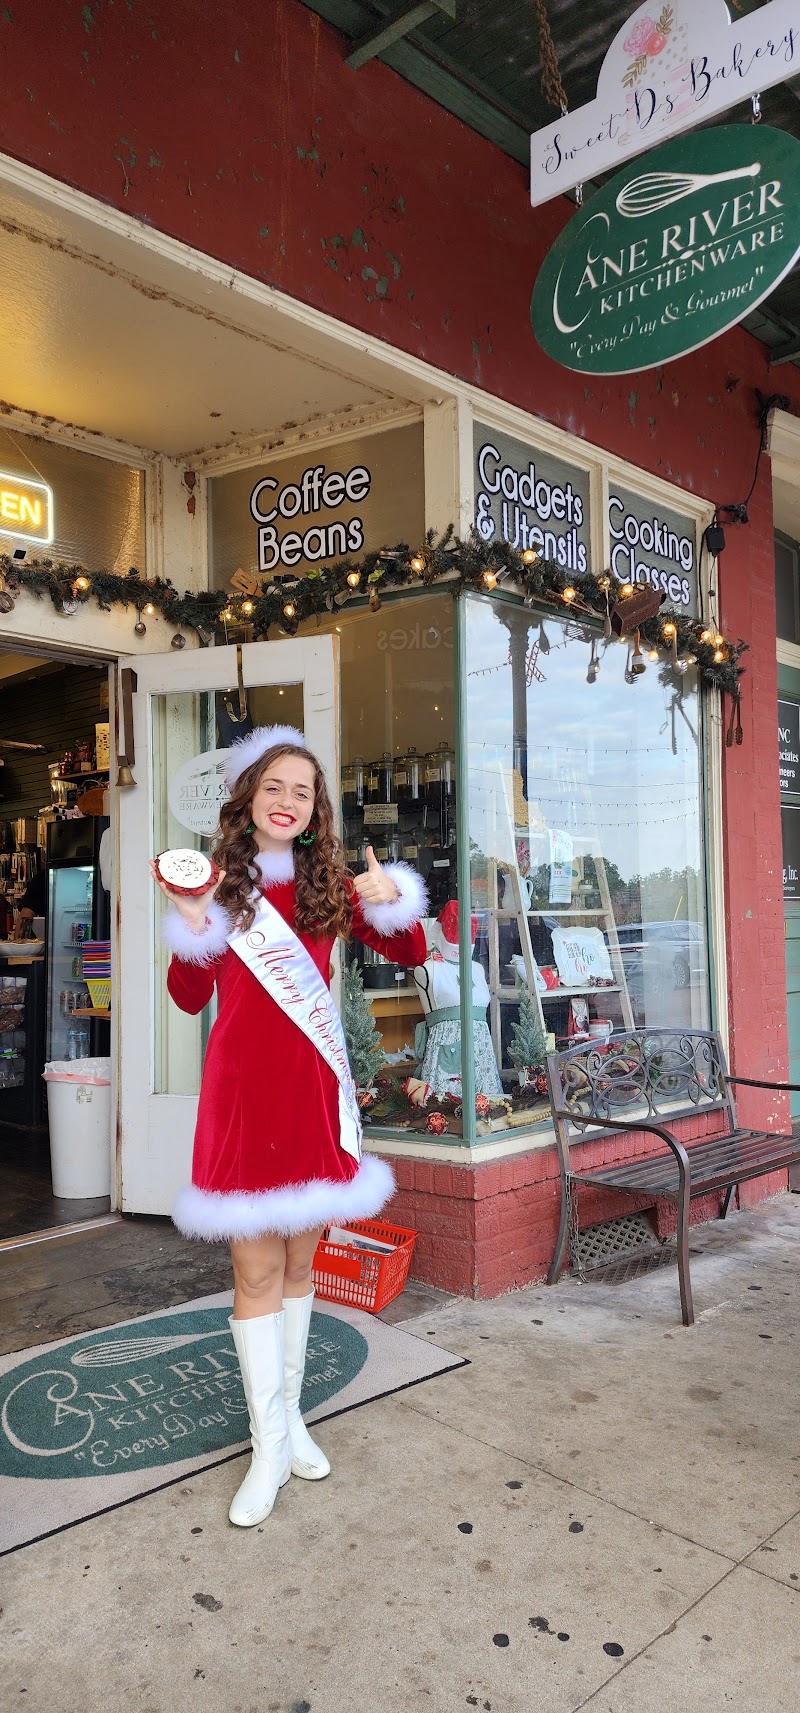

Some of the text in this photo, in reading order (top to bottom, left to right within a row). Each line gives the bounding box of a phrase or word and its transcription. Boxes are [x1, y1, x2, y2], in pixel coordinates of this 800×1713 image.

[541, 27, 800, 174] Sweet D's Bakery
[552, 180, 785, 334] CANE RIVER
[600, 221, 785, 315] KITCHENWARE
[620, 315, 657, 342] Day
[661, 302, 681, 325] &
[0, 490, 42, 526] EN
[250, 465, 371, 524] Coffee
[478, 443, 583, 527] Gadgets
[258, 517, 364, 572] Beans
[477, 493, 587, 573] & Utensils
[608, 495, 693, 572] Cooking
[611, 541, 690, 605] Classes
[246, 931, 351, 1080] Merry Christm
[1, 1370, 164, 1456] CANE
[75, 1434, 169, 1467] "Every
[163, 1411, 229, 1439] Day
